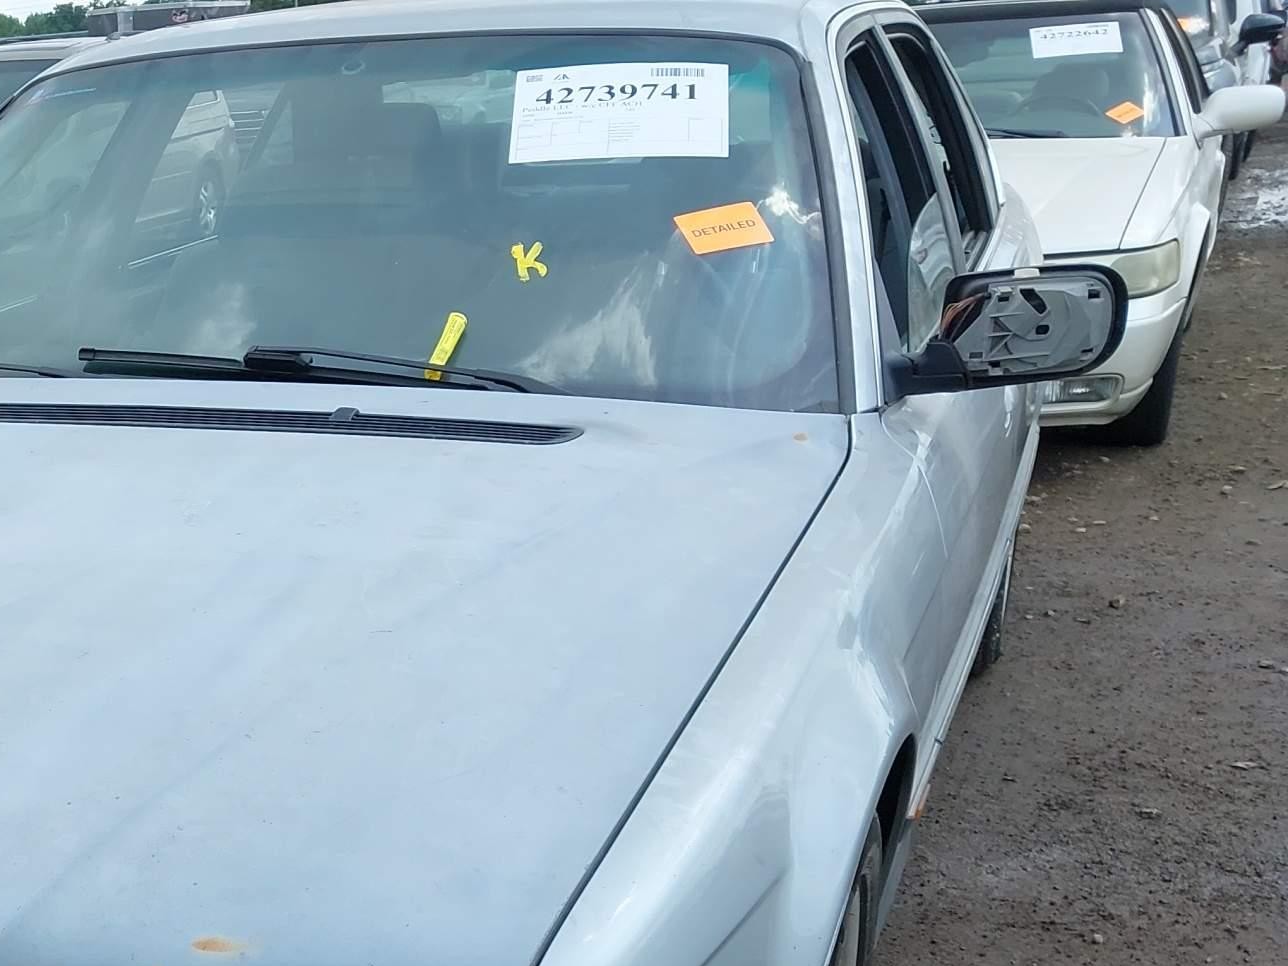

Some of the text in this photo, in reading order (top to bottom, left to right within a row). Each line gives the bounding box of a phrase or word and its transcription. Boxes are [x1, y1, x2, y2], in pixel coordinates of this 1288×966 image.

[535, 82, 697, 105] 42739741
[691, 219, 757, 238] DETAILED
[511, 240, 548, 281] K
